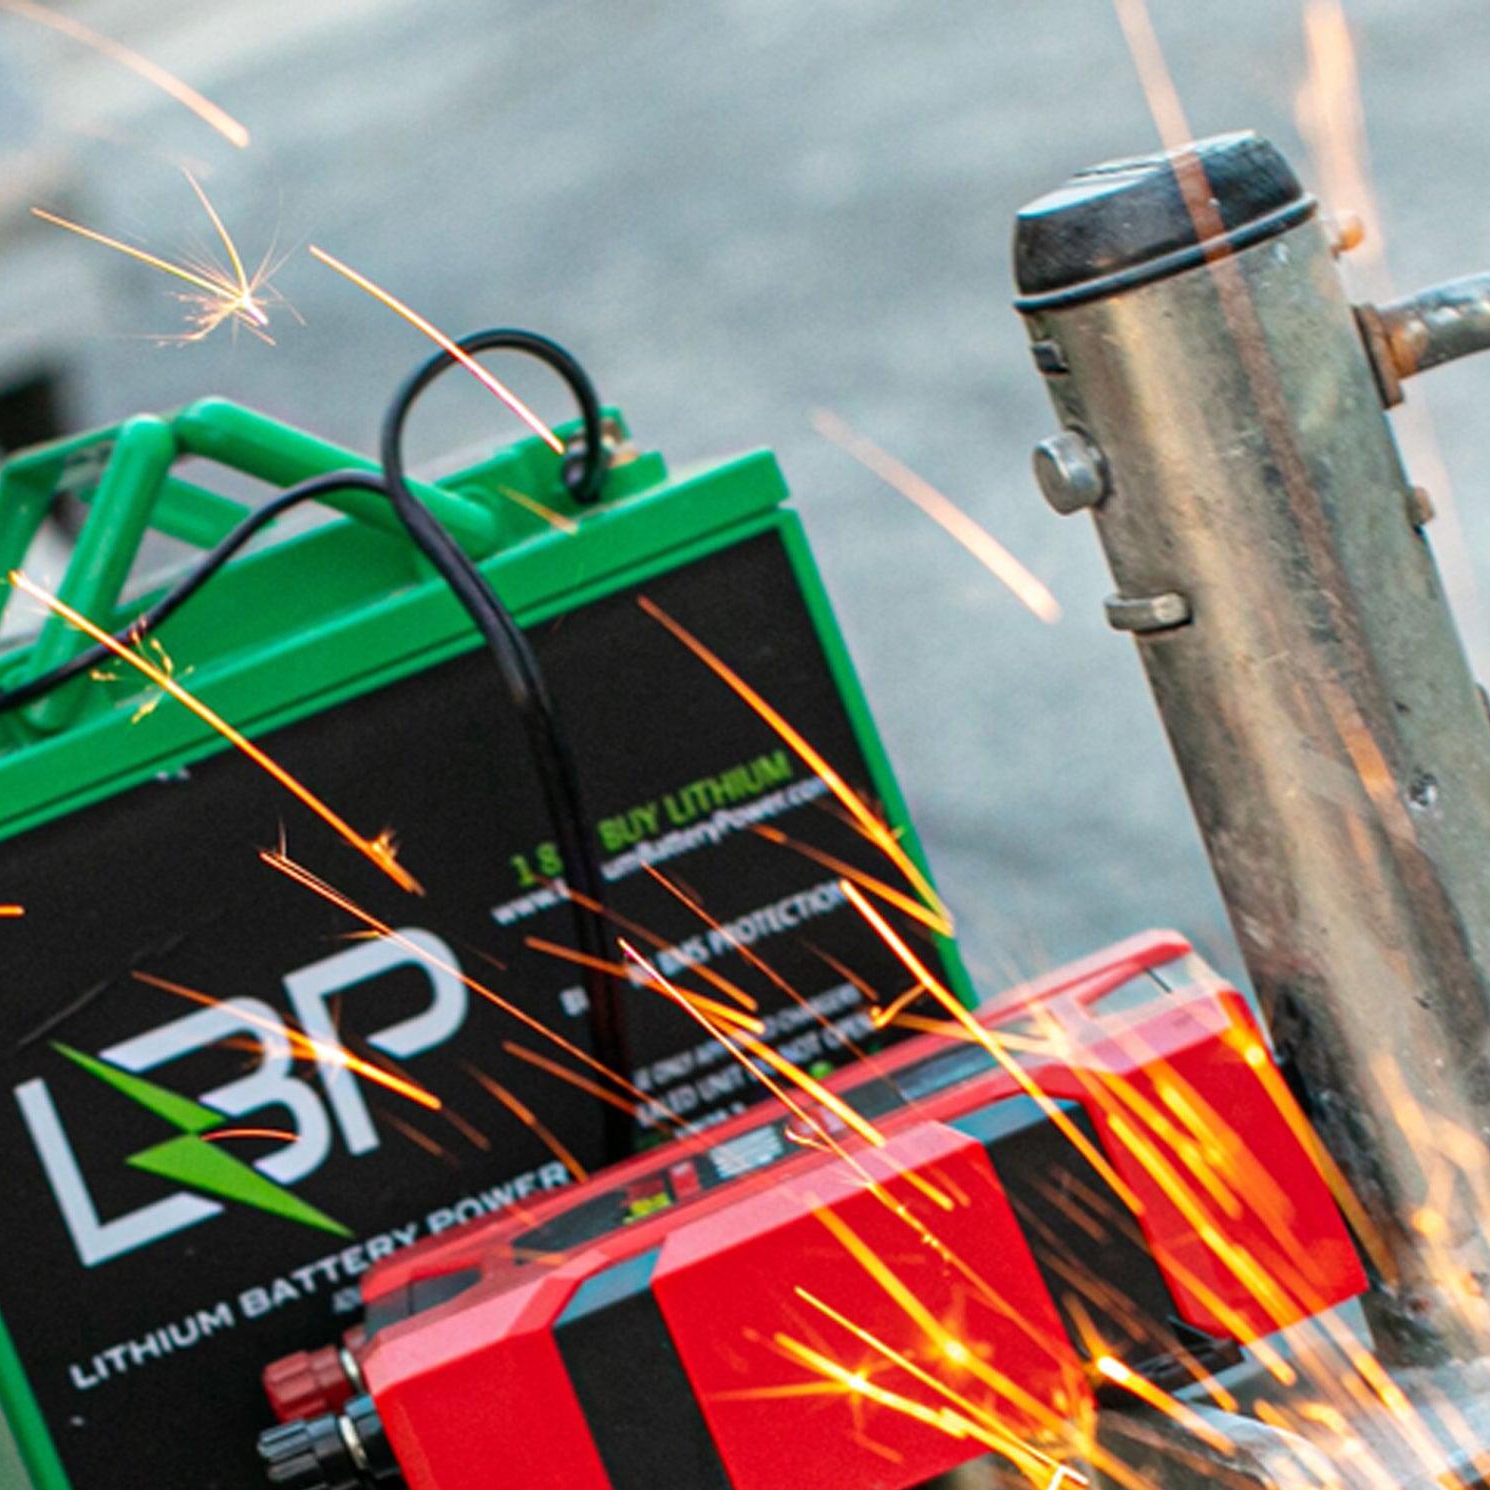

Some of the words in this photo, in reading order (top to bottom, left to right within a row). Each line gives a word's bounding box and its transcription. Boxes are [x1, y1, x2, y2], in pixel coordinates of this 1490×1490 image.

[598, 804, 659, 852] BUY
[664, 750, 794, 822] LITHIUM
[706, 879, 849, 955] PROTECTION
[13, 927, 468, 1268] LBP
[69, 1303, 234, 1390] LITHIUM
[239, 1220, 418, 1320] BATTERY
[427, 1160, 571, 1238] POWER
